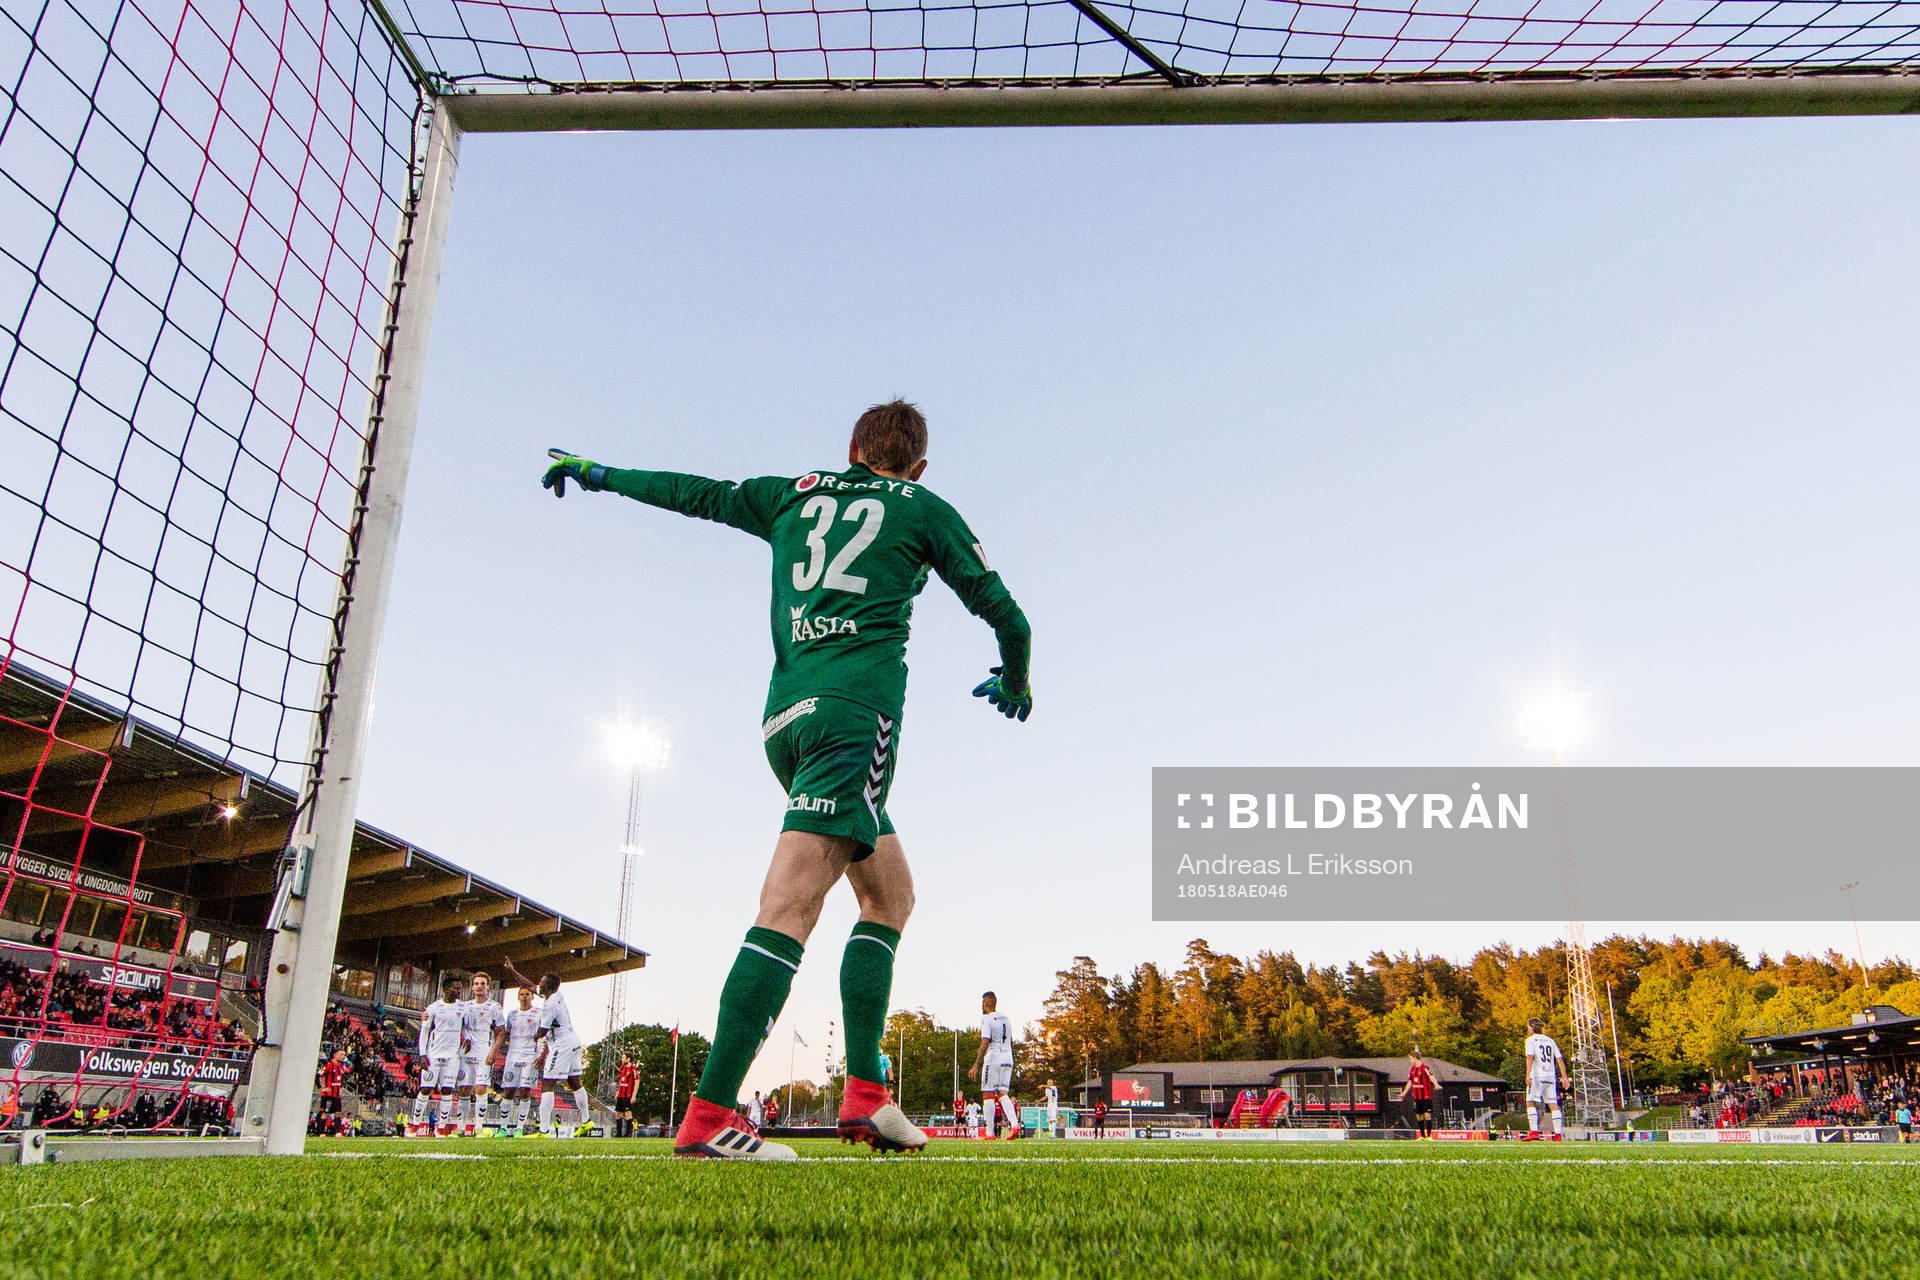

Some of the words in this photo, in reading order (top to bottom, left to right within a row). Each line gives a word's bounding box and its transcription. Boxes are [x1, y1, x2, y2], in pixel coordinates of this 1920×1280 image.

[791, 495, 885, 595] 32
[791, 616, 859, 643] RASTA
[8, 854, 48, 875] YGGER
[48, 865, 85, 885] SVENK
[84, 875, 154, 903] UNGDOMSIROTT
[1539, 1045, 1552, 1063] 39
[80, 1049, 168, 1078] Volkswagen
[171, 1058, 240, 1081] Stockholm
[1107, 1130, 1129, 1138] LINE
[1717, 1131, 1752, 1141] BAUHAUS
[1773, 1133, 1802, 1142] Volkswagen
[1852, 1131, 1881, 1140] stadium
